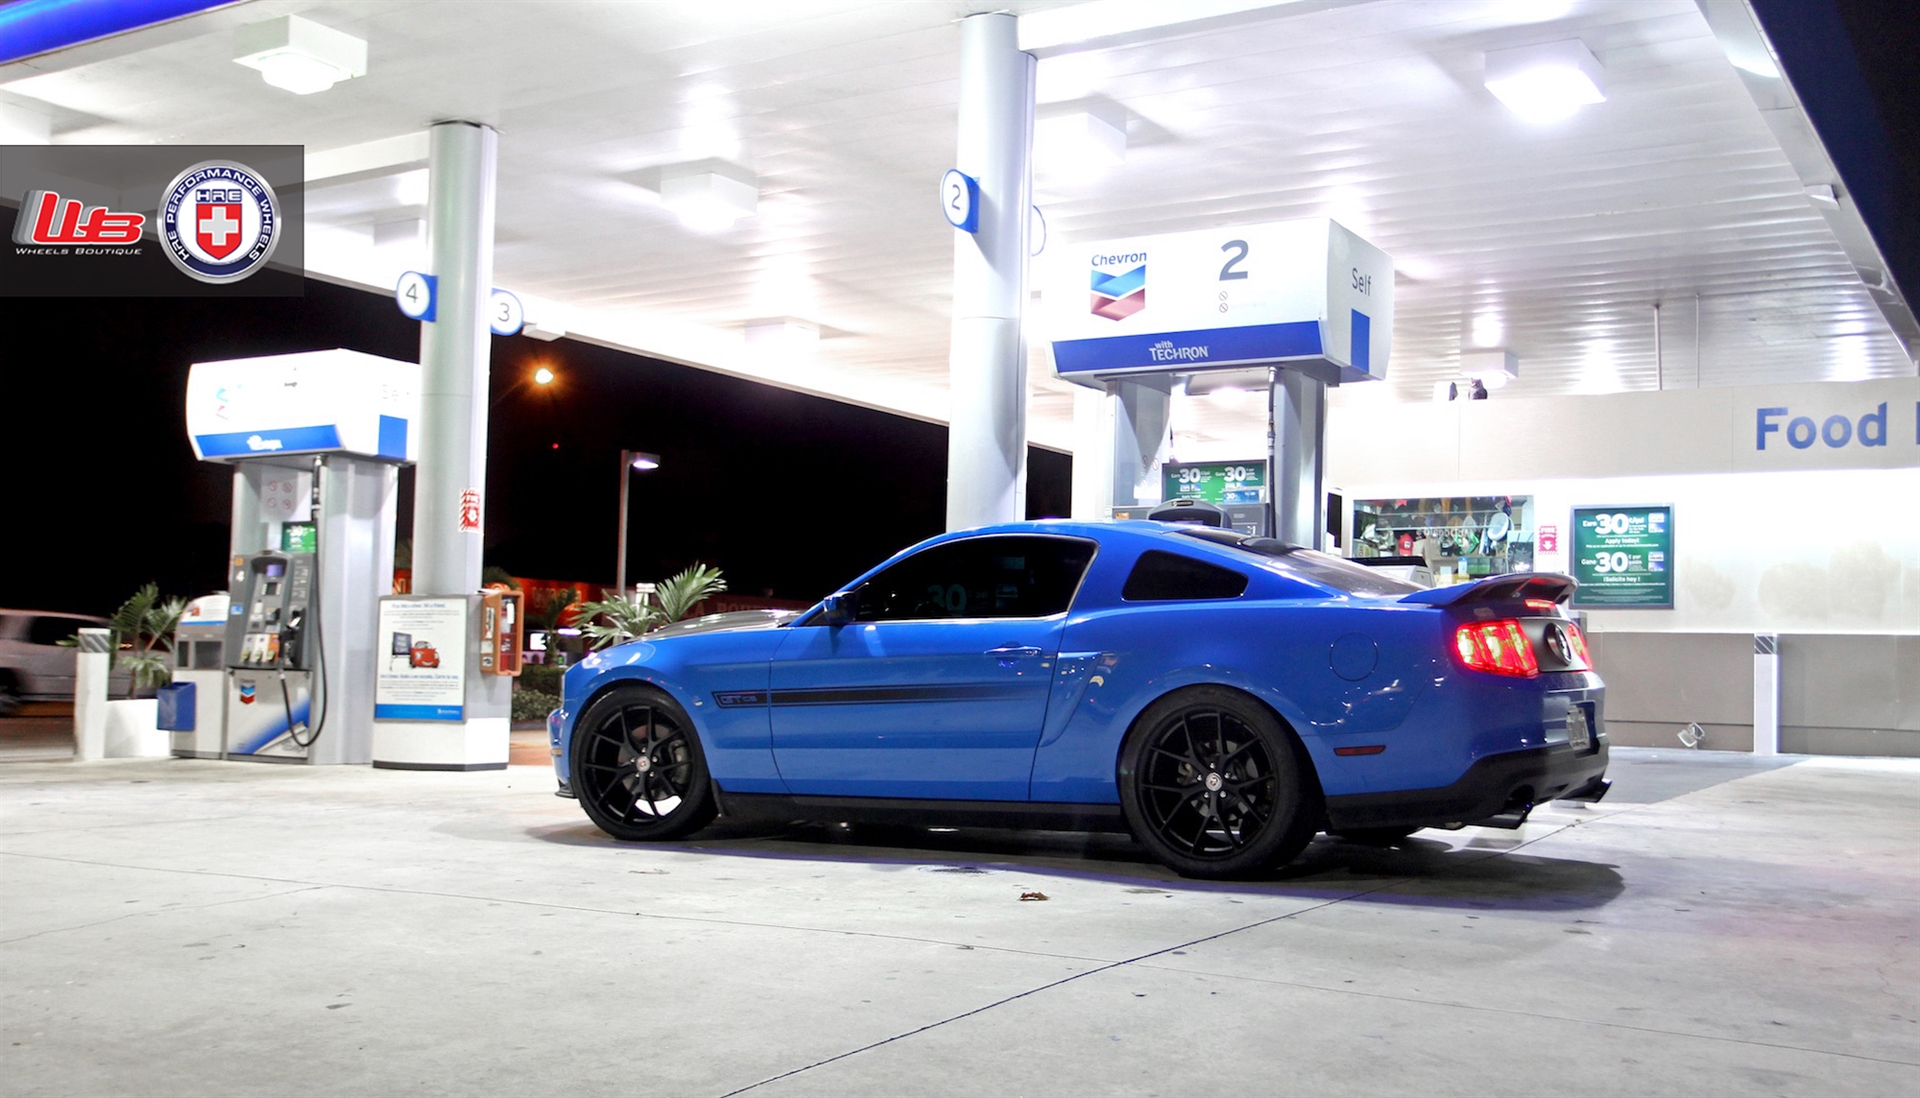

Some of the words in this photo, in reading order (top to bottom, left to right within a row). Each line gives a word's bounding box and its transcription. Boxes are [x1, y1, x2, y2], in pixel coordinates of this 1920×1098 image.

[951, 184, 961, 211] 2
[1091, 251, 1148, 267] Chevron
[1218, 239, 1249, 282] 2
[1351, 267, 1372, 297] Self
[405, 283, 418, 303] 4
[497, 302, 510, 322] 3
[1148, 346, 1209, 361] TECHRON
[1154, 340, 1174, 349] with
[1756, 401, 1888, 450] Food
[1179, 468, 1201, 483] 30
[1224, 466, 1246, 482] 30
[1594, 513, 1629, 534] 30
[1594, 551, 1629, 573] 30
